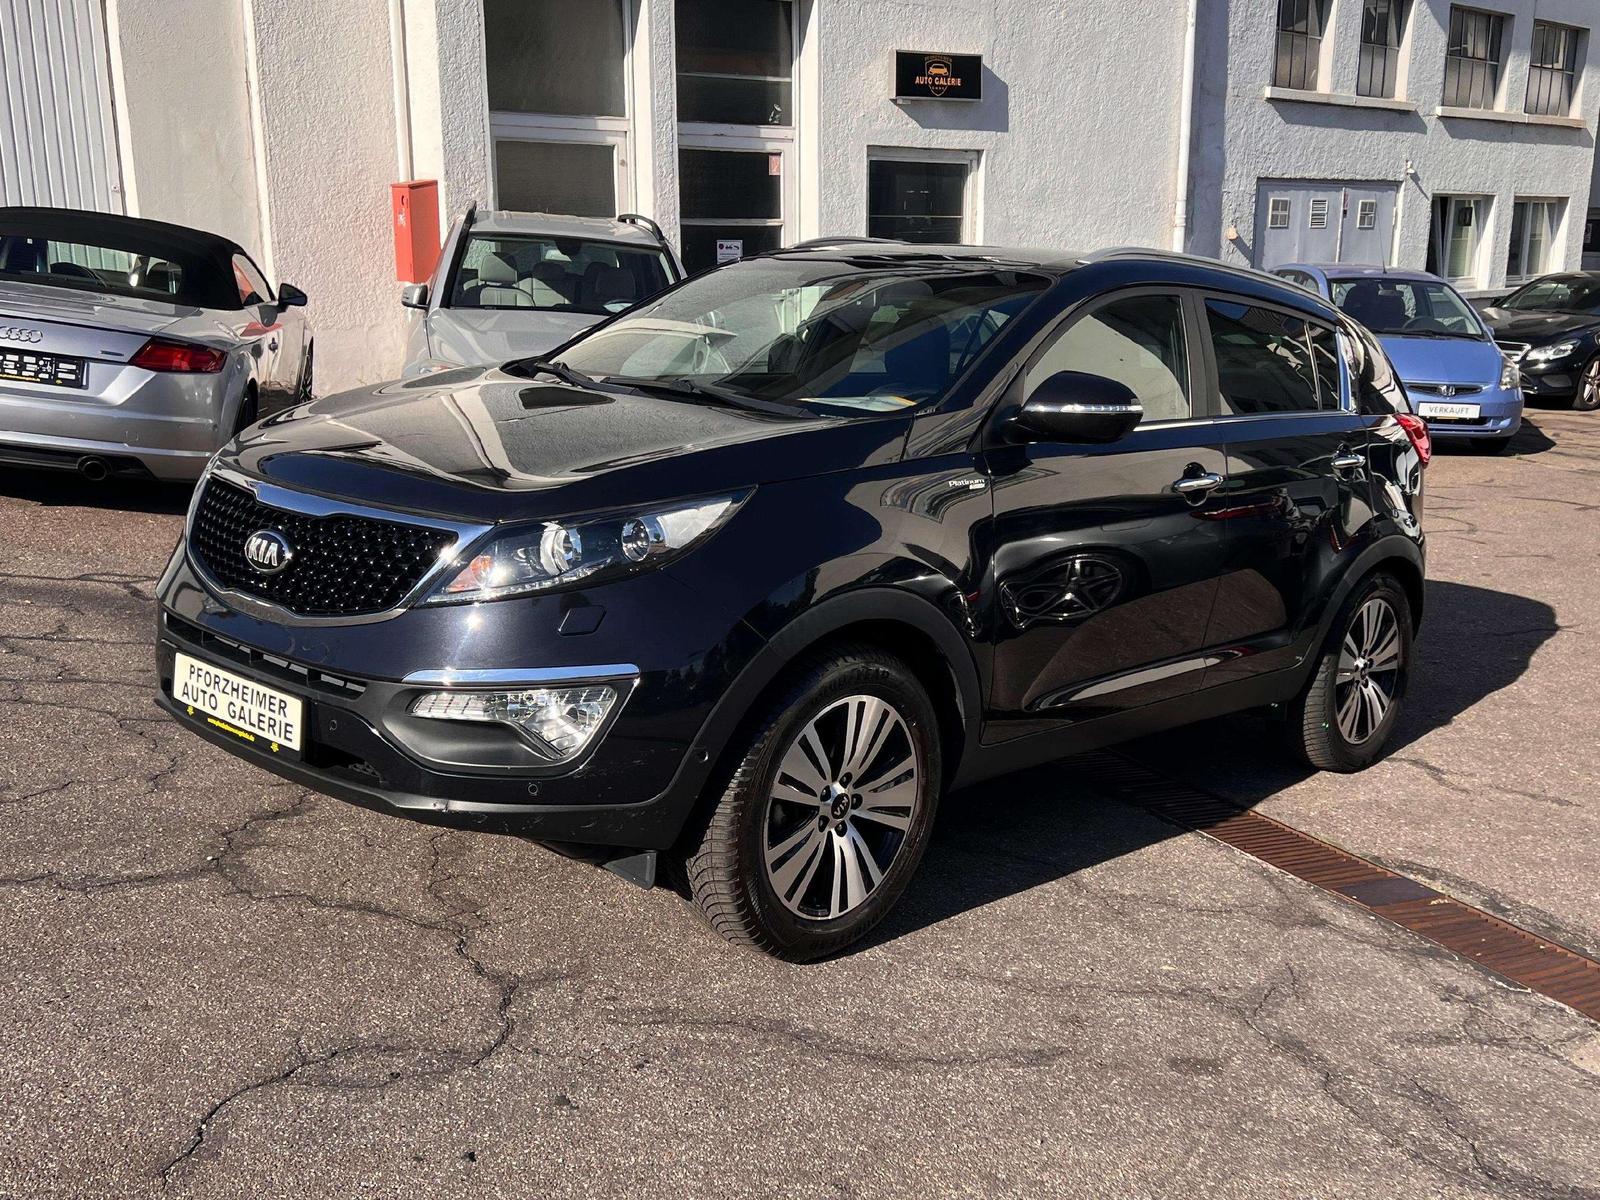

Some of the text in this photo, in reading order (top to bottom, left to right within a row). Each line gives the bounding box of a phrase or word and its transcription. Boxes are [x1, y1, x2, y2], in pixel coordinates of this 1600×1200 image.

[915, 76, 962, 86] AUTO GALERIE
[1429, 406, 1470, 415] VERKAUFT
[948, 478, 985, 488] Platinum
[248, 537, 278, 566] KIA
[189, 664, 288, 718] PFORZHEIMER
[181, 683, 218, 711] AUTO
[227, 702, 294, 742] GALERIE
